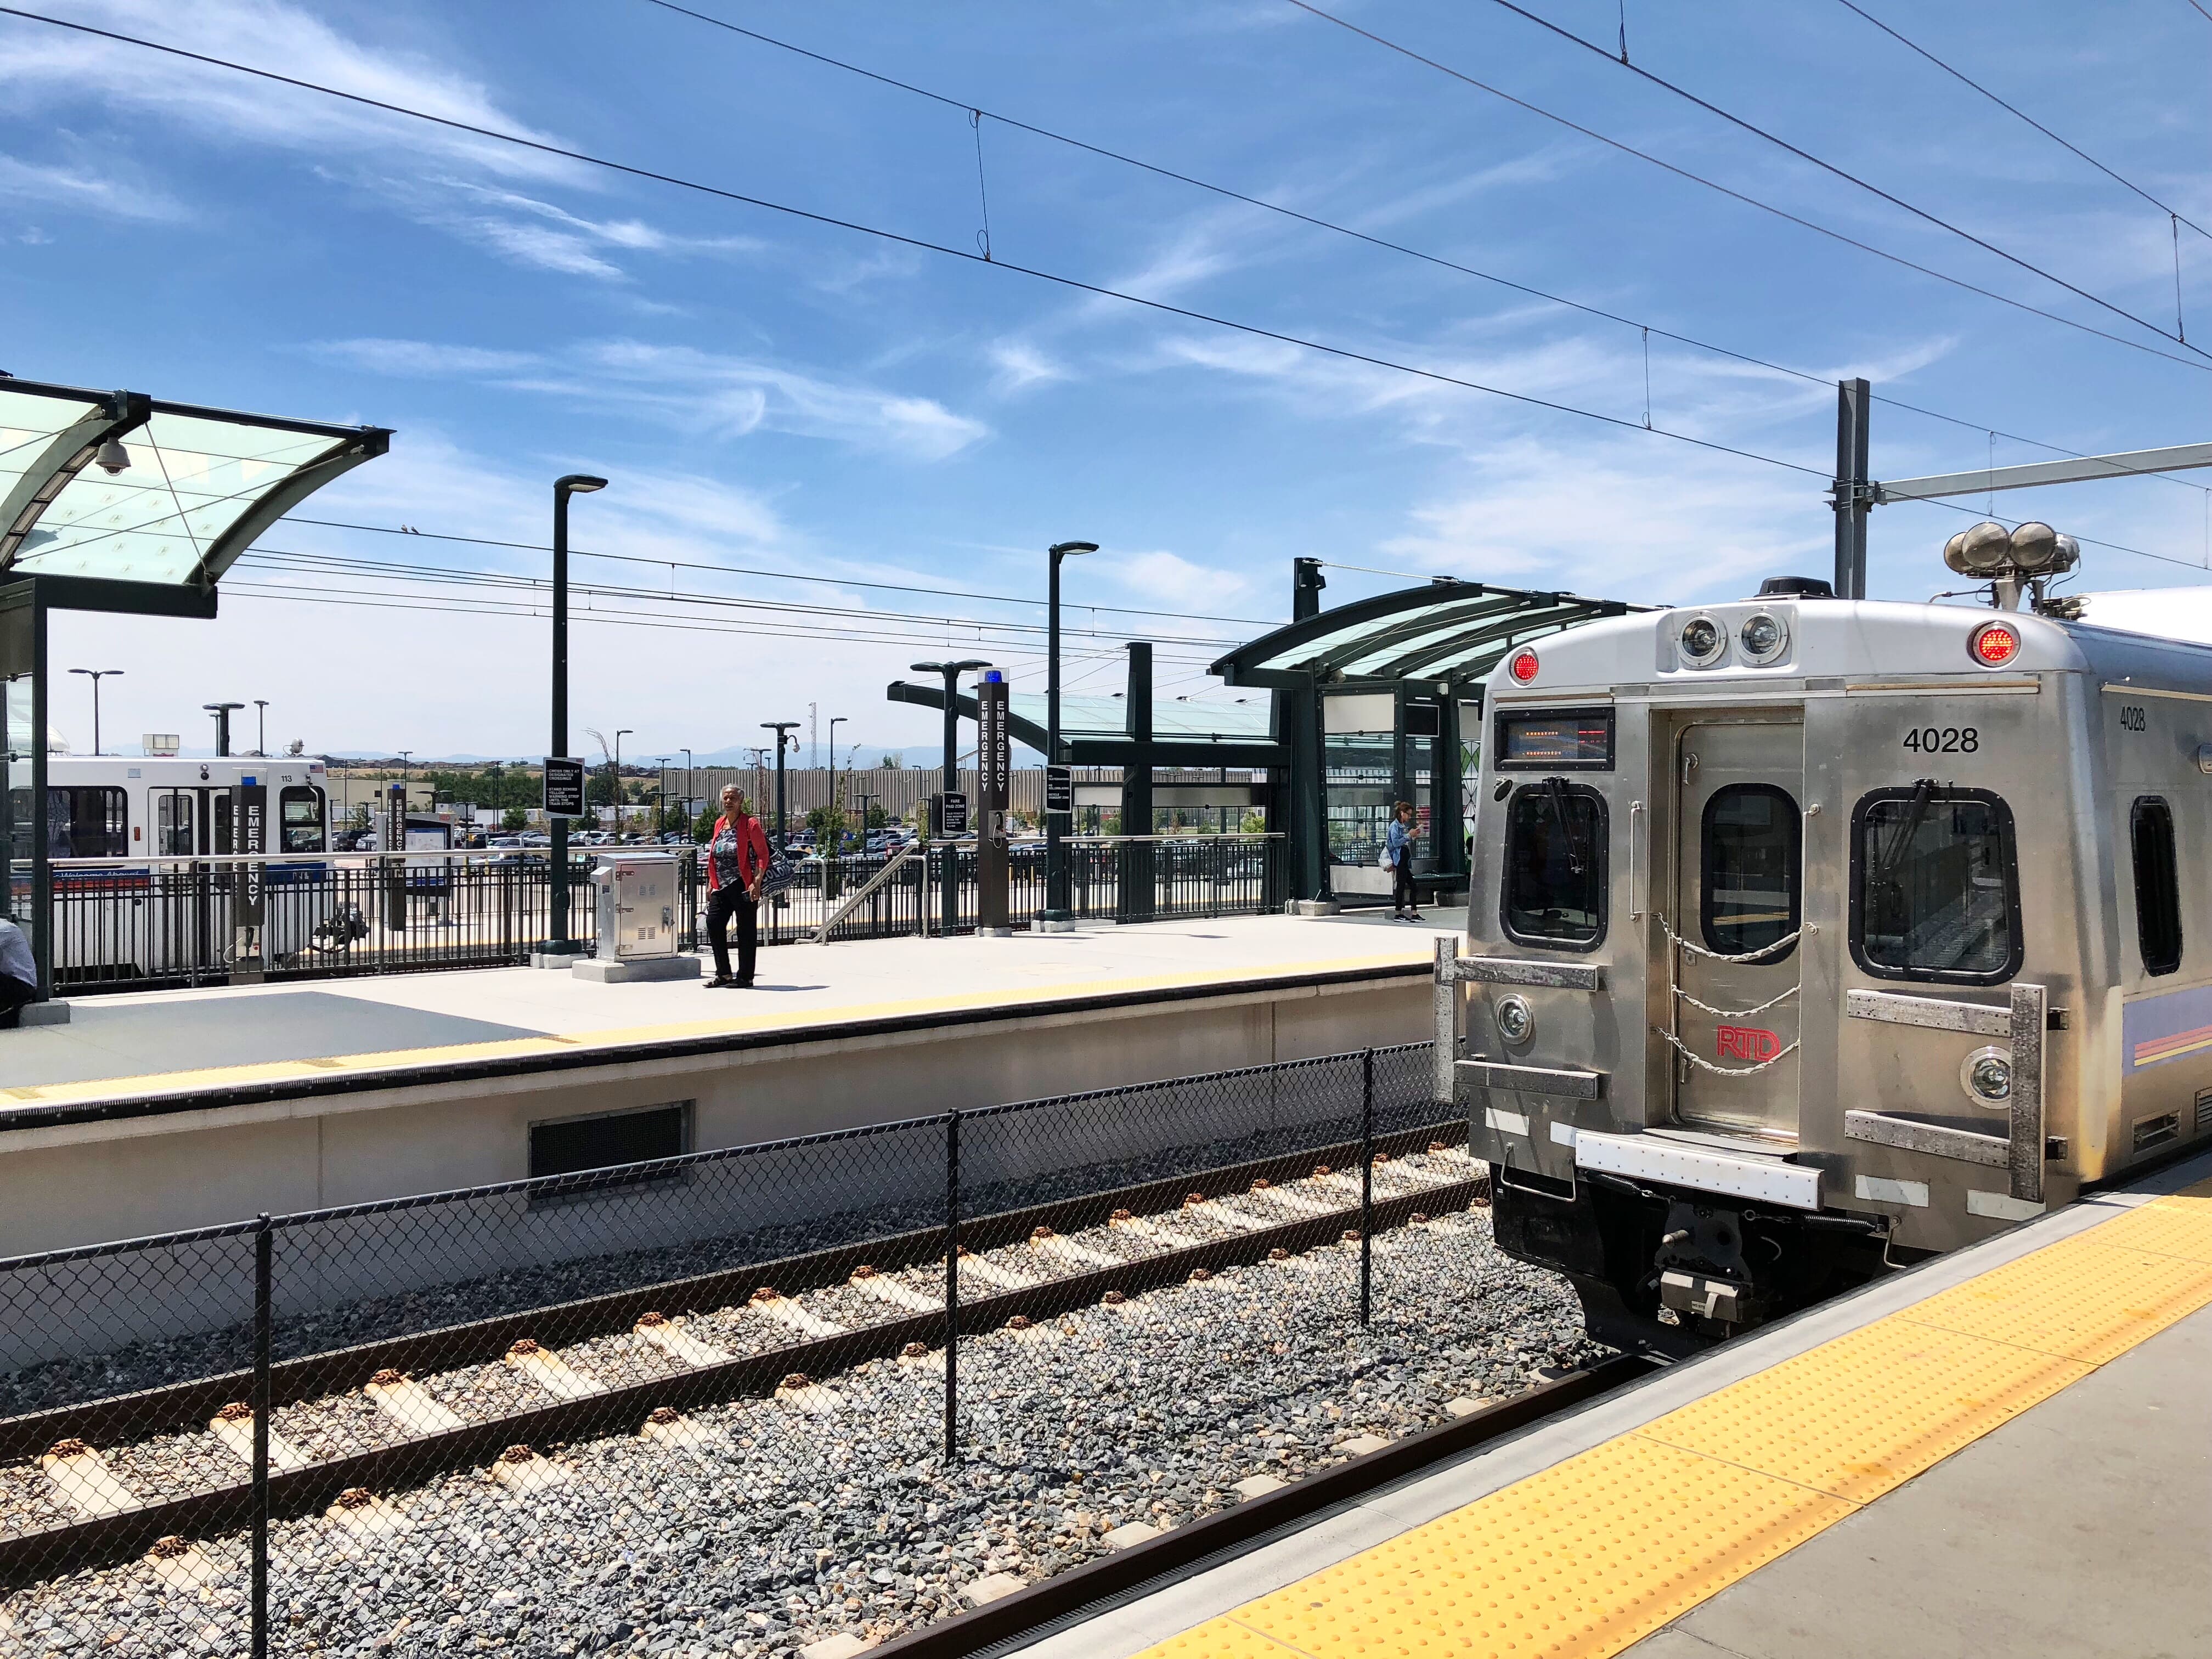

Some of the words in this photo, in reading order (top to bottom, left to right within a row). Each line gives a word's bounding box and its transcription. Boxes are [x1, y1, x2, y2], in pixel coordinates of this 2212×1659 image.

[2120, 706, 2146, 731] 4028
[1903, 727, 1979, 753] 4028
[1717, 1025, 1781, 1063] RTD
